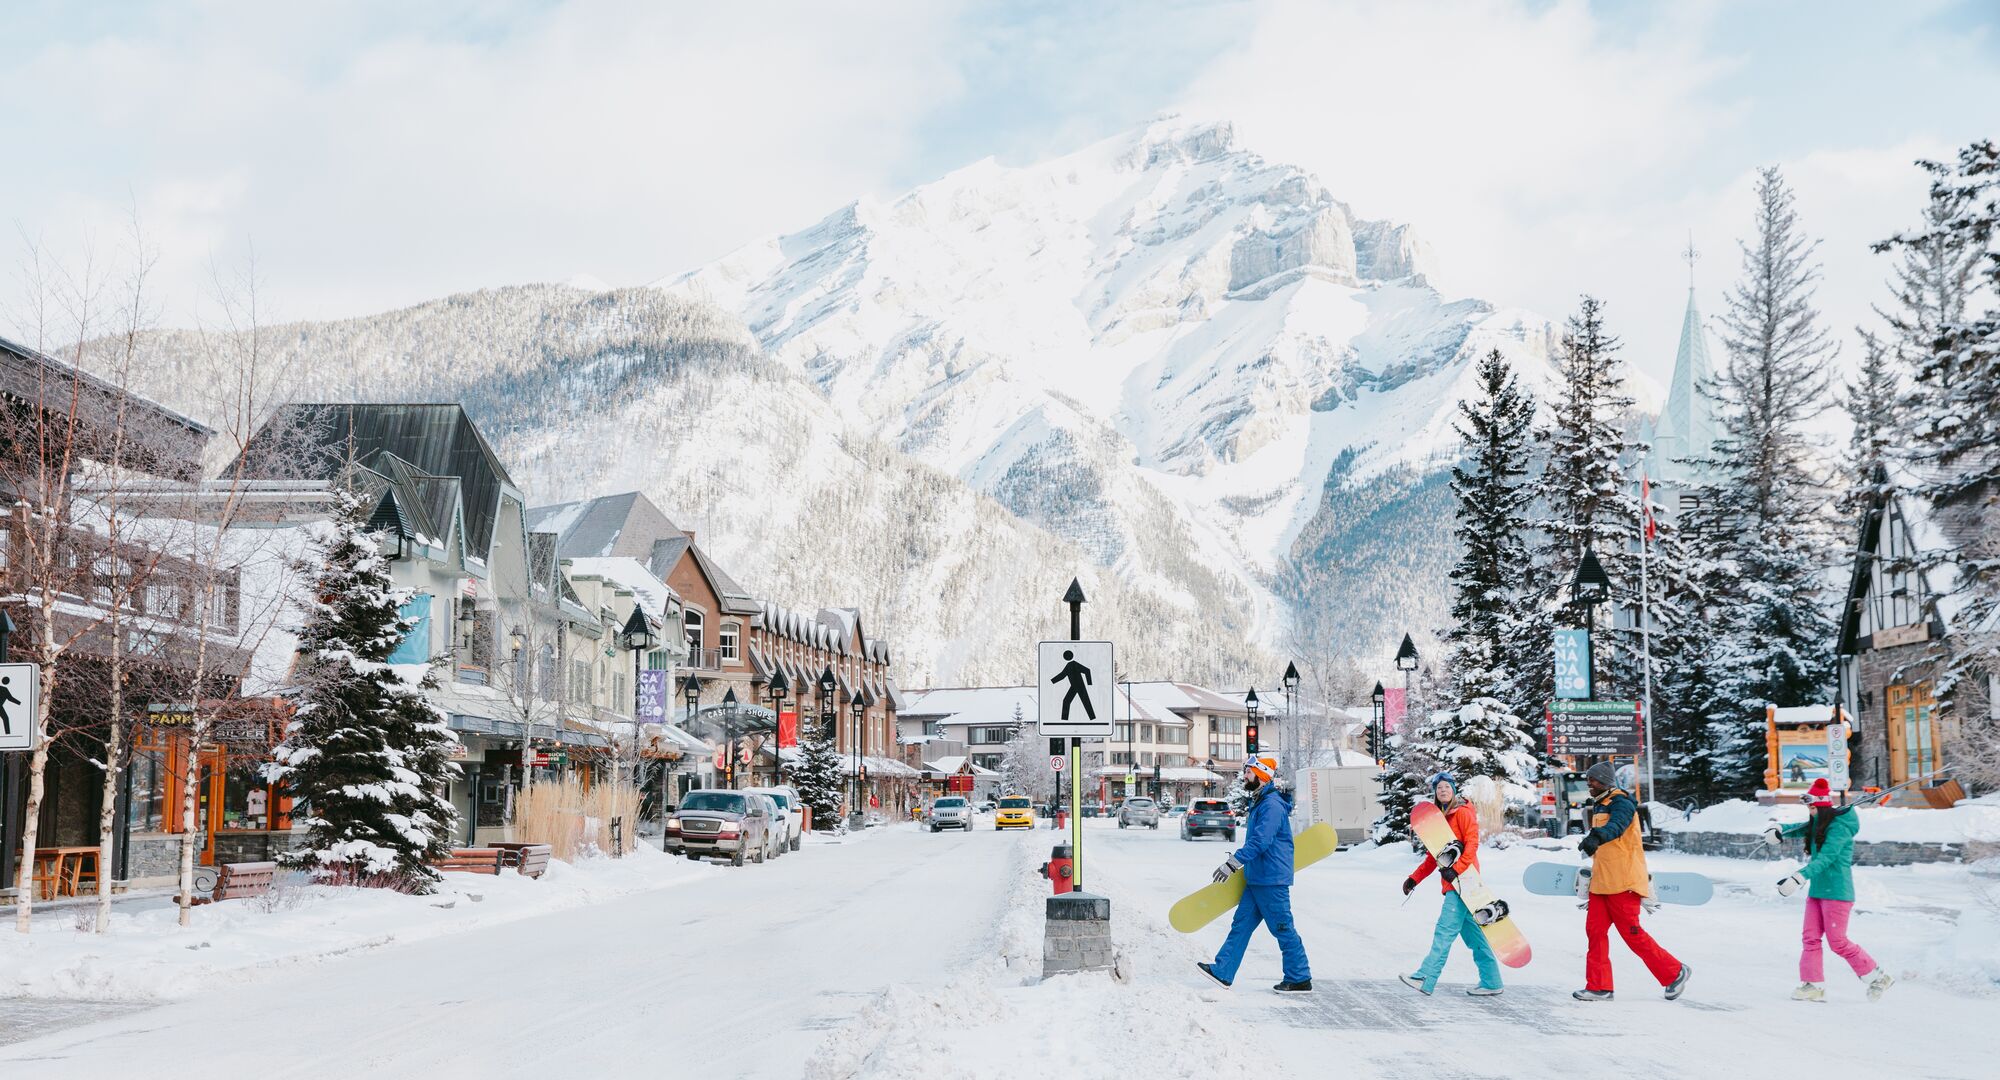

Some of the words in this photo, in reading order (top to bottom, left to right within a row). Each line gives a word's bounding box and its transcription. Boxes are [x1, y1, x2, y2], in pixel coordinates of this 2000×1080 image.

[1554, 634, 1578, 648] CA
[1554, 649, 1578, 662] NA
[1554, 663, 1580, 676] DA
[639, 672, 658, 683] CA
[639, 684, 658, 694] NA
[639, 695, 658, 705] DA
[746, 709, 772, 720] SHOPS
[1608, 714, 1634, 722] Highway
[216, 729, 266, 739] SILVER
[1310, 771, 1320, 824] GARDAWORLD
